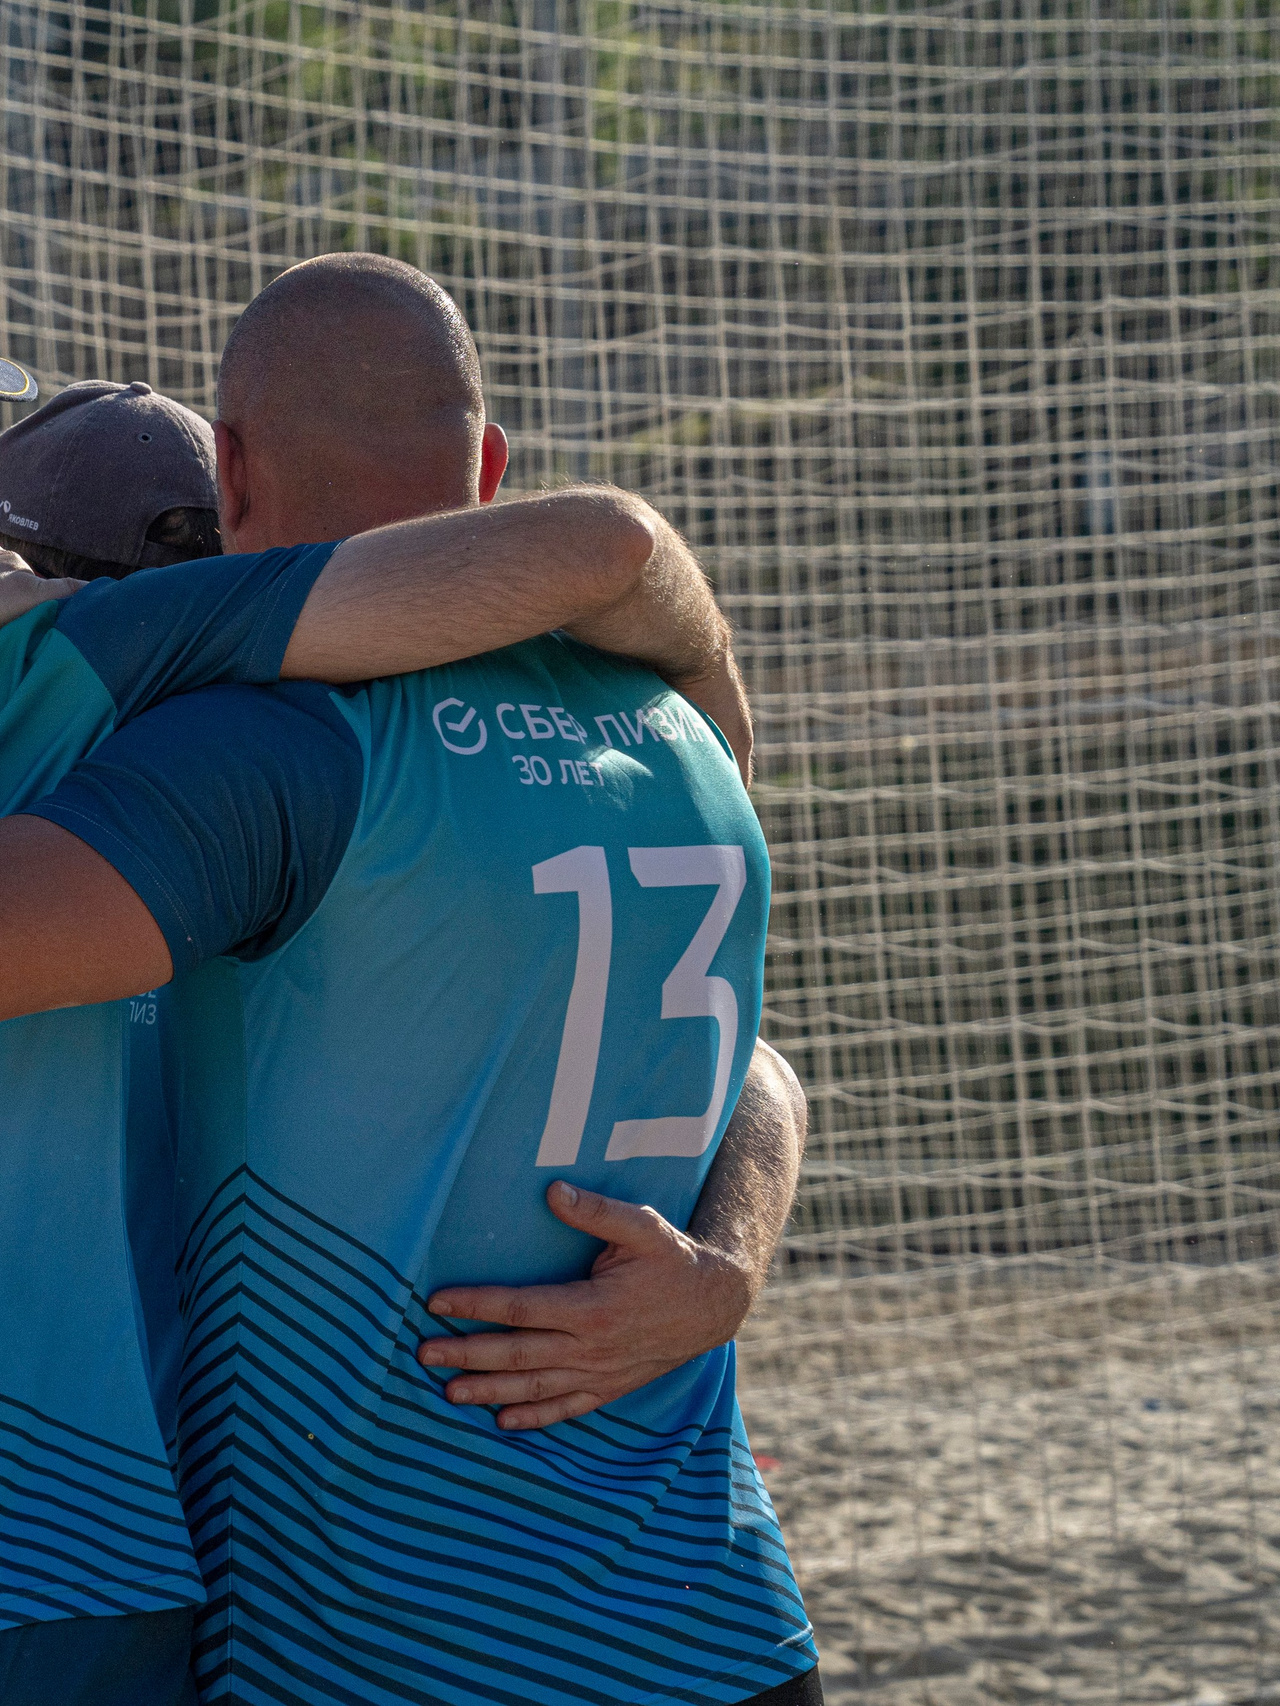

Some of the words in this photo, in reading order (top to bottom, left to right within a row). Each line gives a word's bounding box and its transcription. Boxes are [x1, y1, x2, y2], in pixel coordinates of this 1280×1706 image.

[7, 513, 39, 531] ЯКОВЛЕВ
[496, 702, 588, 745] СБЕР
[512, 754, 552, 786] 30
[558, 759, 605, 787] ЛЕТ
[531, 845, 747, 1167] 13
